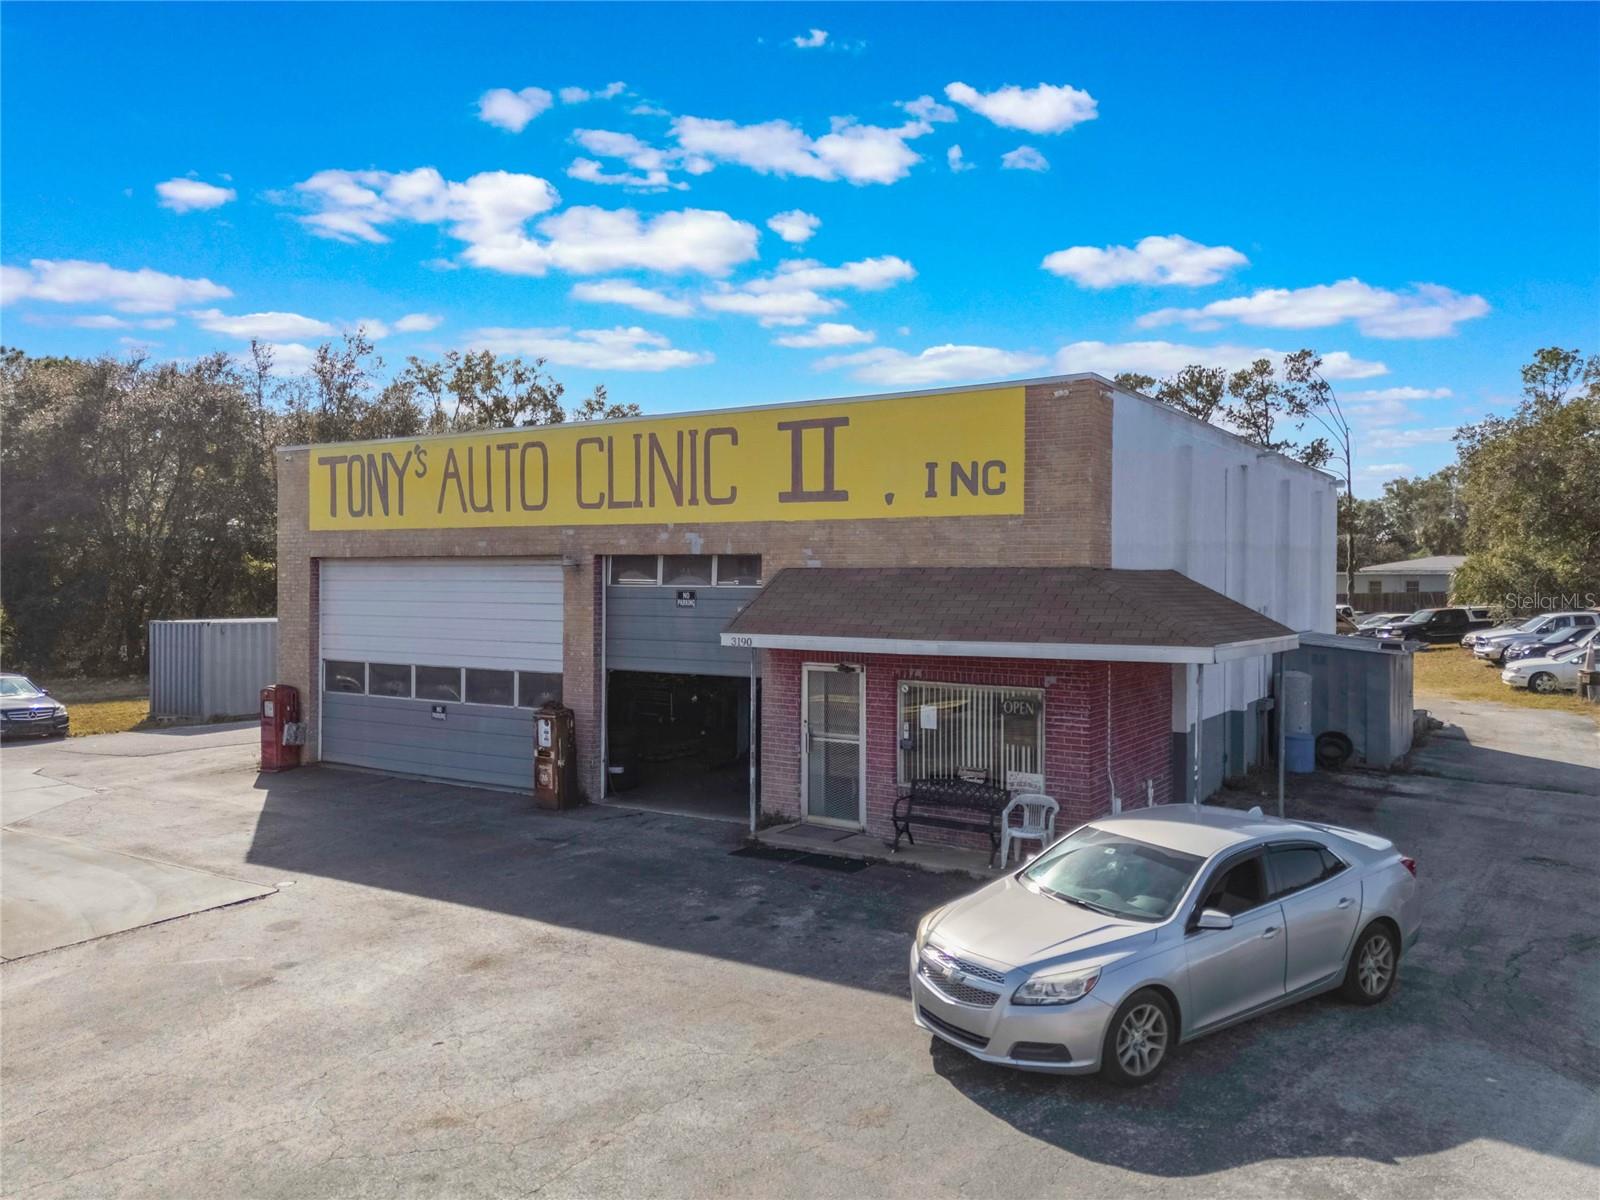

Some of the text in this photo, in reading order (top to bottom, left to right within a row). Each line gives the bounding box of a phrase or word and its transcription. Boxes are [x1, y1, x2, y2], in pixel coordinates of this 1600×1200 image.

[437, 441, 548, 514] AUTO
[576, 427, 738, 510] CLINIC
[925, 460, 1006, 498] INC
[677, 599, 696, 607] PARKING
[731, 637, 752, 647] 3190
[1003, 701, 1034, 715] OPEN
